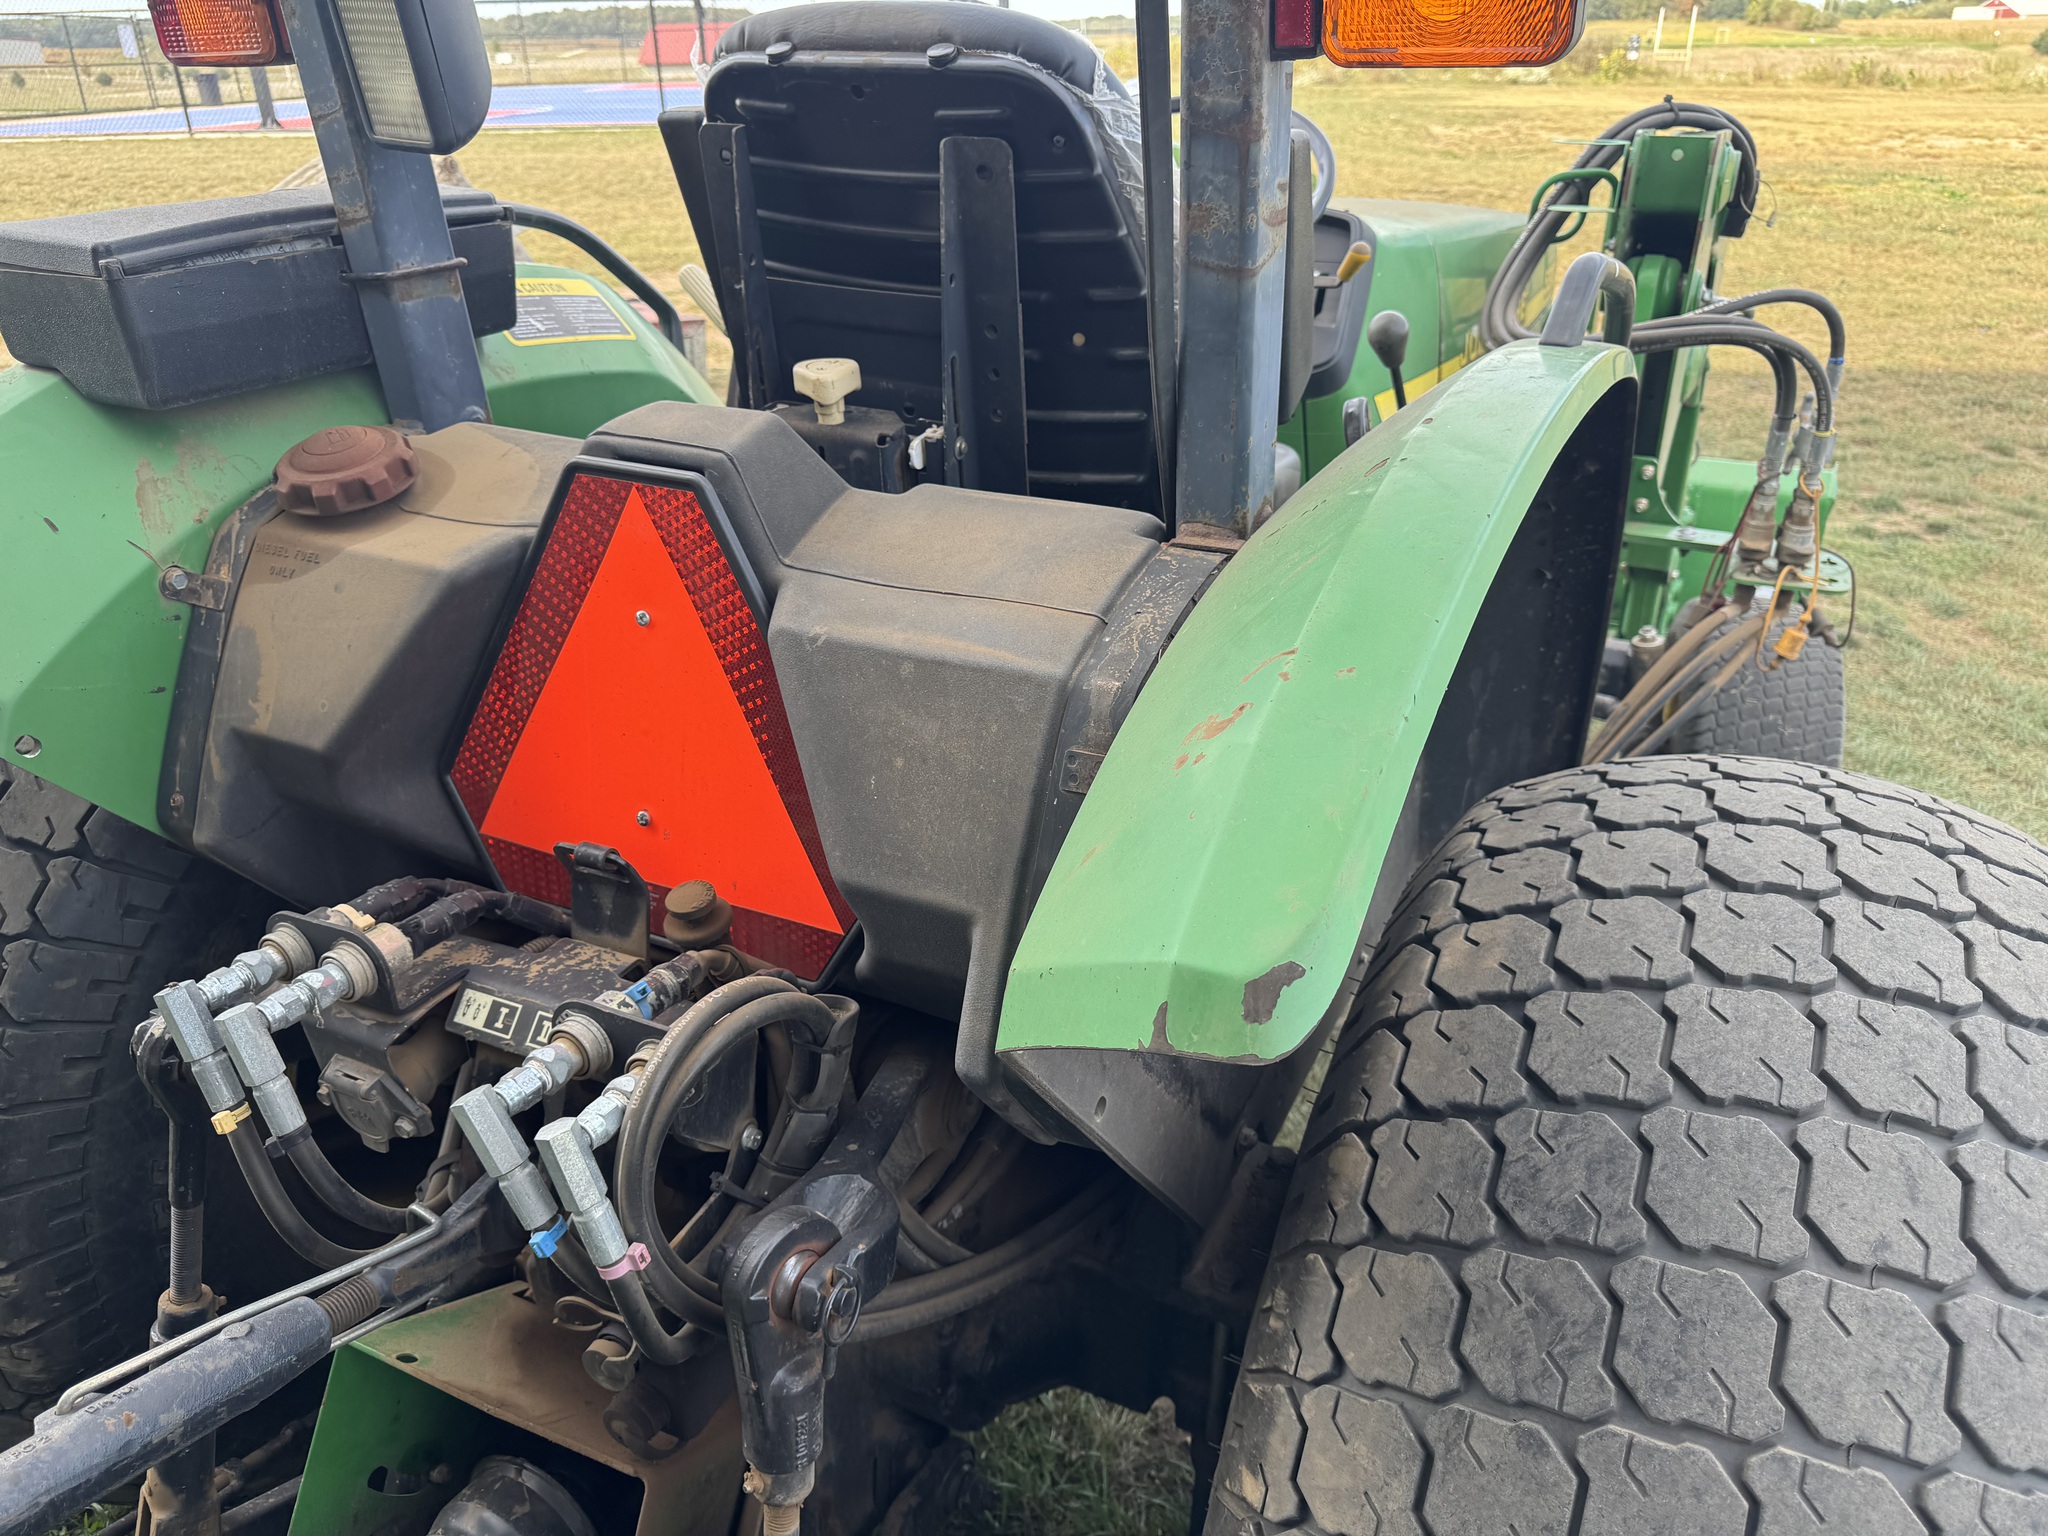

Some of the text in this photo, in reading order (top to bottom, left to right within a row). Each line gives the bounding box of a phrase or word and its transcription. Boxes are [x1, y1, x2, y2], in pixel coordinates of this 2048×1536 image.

[520, 283, 568, 293] CAUTION
[256, 542, 320, 564] DIESEL FUEL
[270, 565, 296, 579] ONLY
[631, 1010, 696, 1109] www.parker.com
